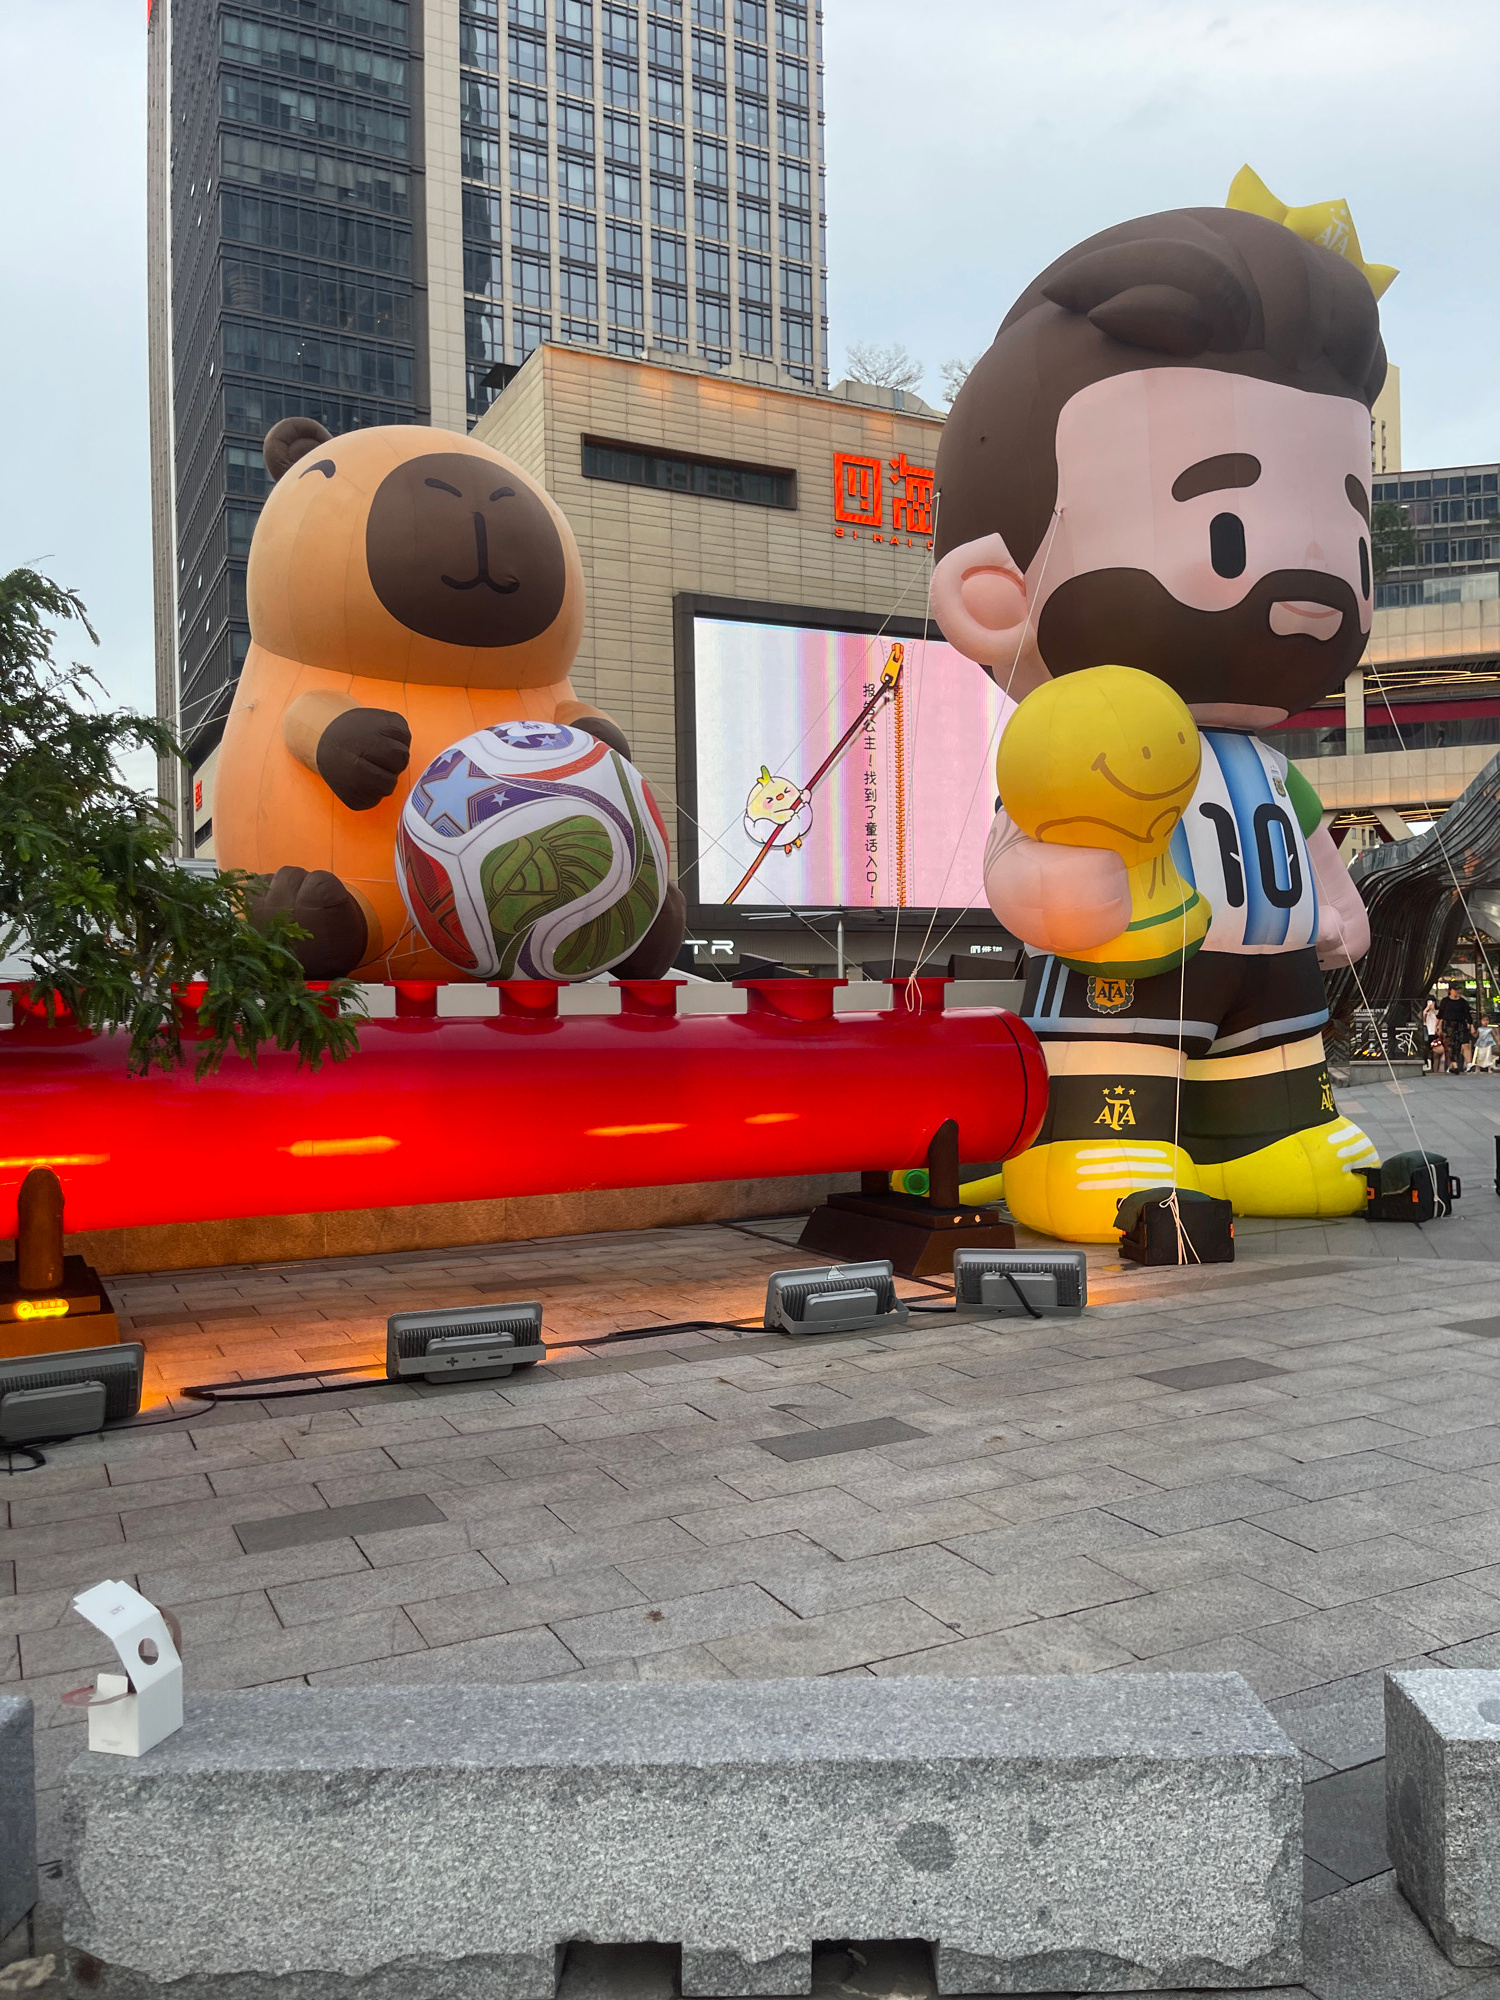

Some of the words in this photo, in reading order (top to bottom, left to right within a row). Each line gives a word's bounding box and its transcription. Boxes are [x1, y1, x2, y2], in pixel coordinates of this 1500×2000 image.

[835, 527, 857, 540] SI
[873, 533, 913, 548] HAI
[1199, 802, 1302, 908] 10
[1096, 979, 1124, 1002] AFA
[1094, 1096, 1136, 1131] AFA
